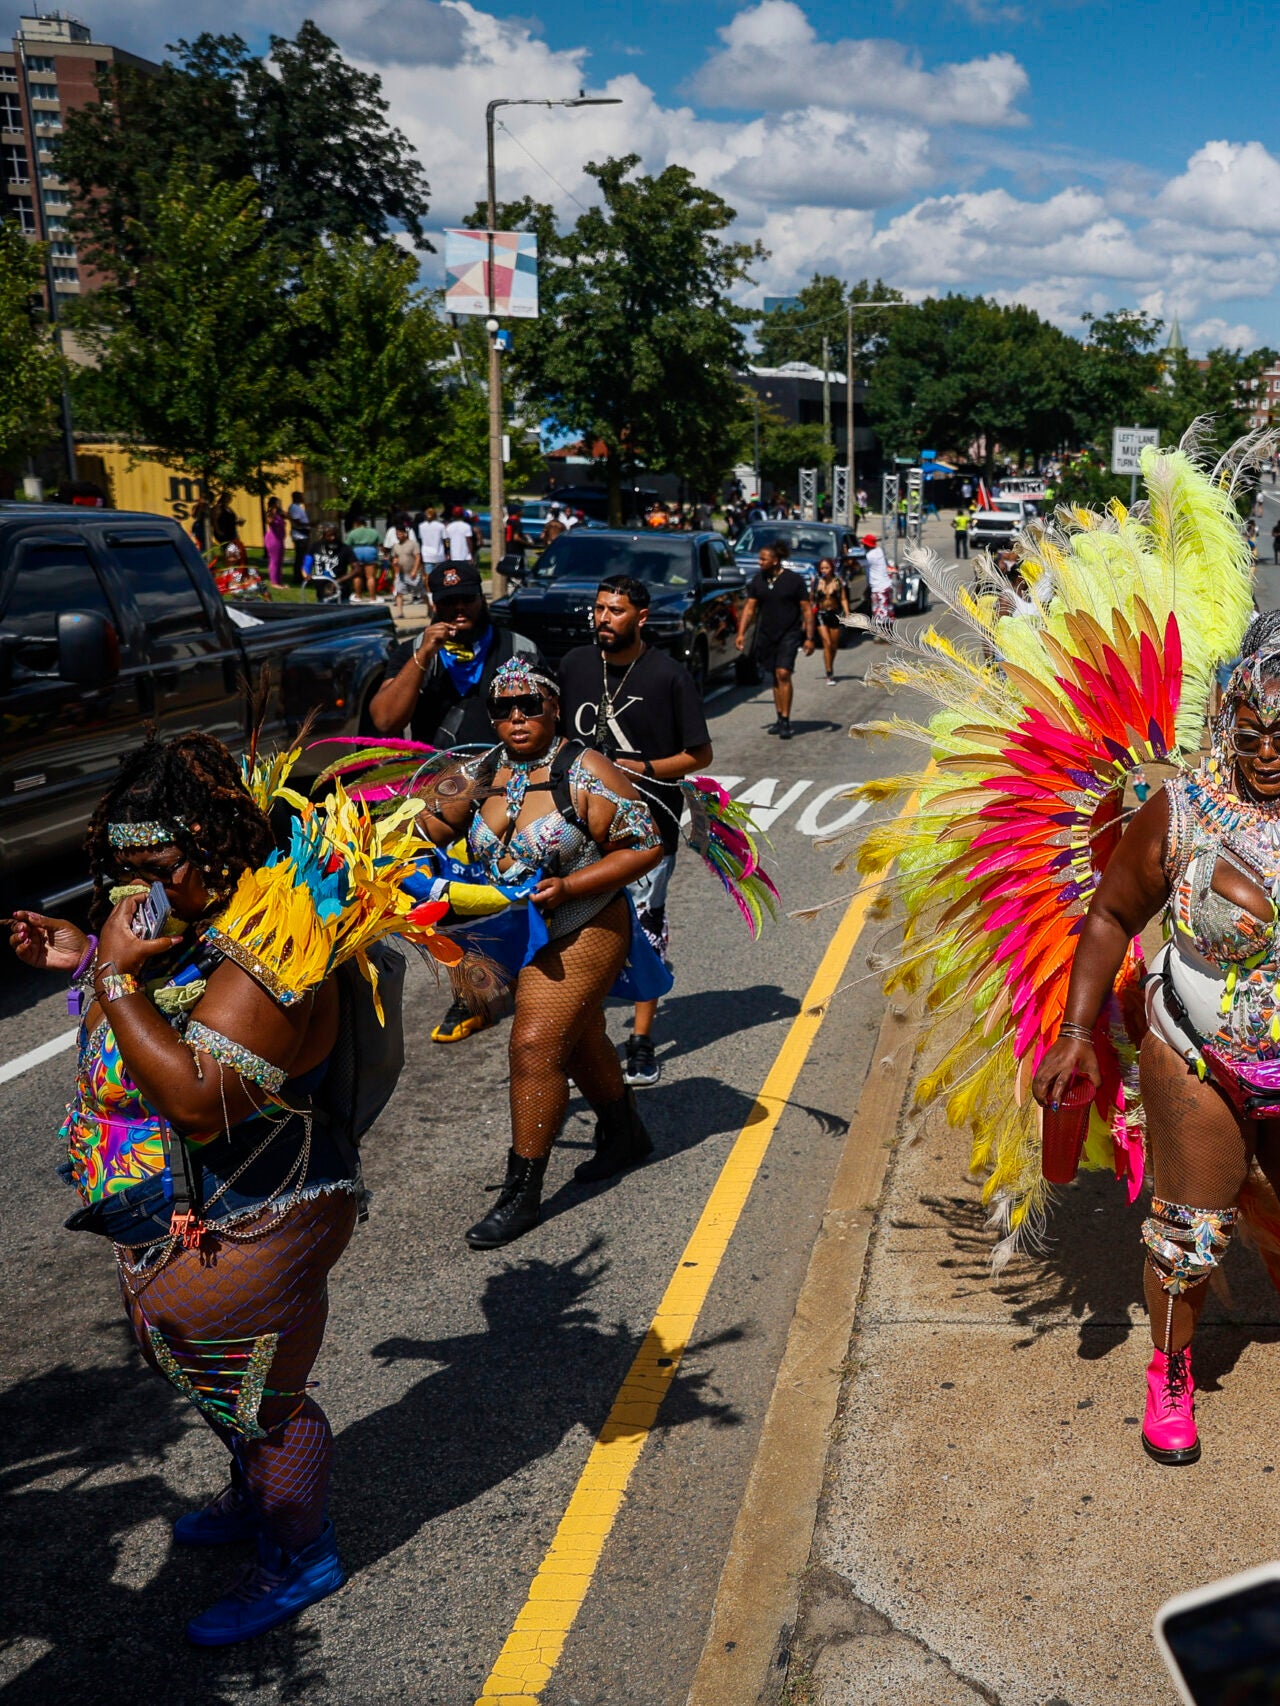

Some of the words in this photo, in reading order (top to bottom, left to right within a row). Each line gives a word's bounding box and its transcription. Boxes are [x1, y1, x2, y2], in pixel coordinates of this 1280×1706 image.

[1119, 434, 1134, 443] LEFT
[1138, 435, 1155, 445] LANE
[1122, 446, 1143, 457] MUS
[575, 695, 644, 754] CK
